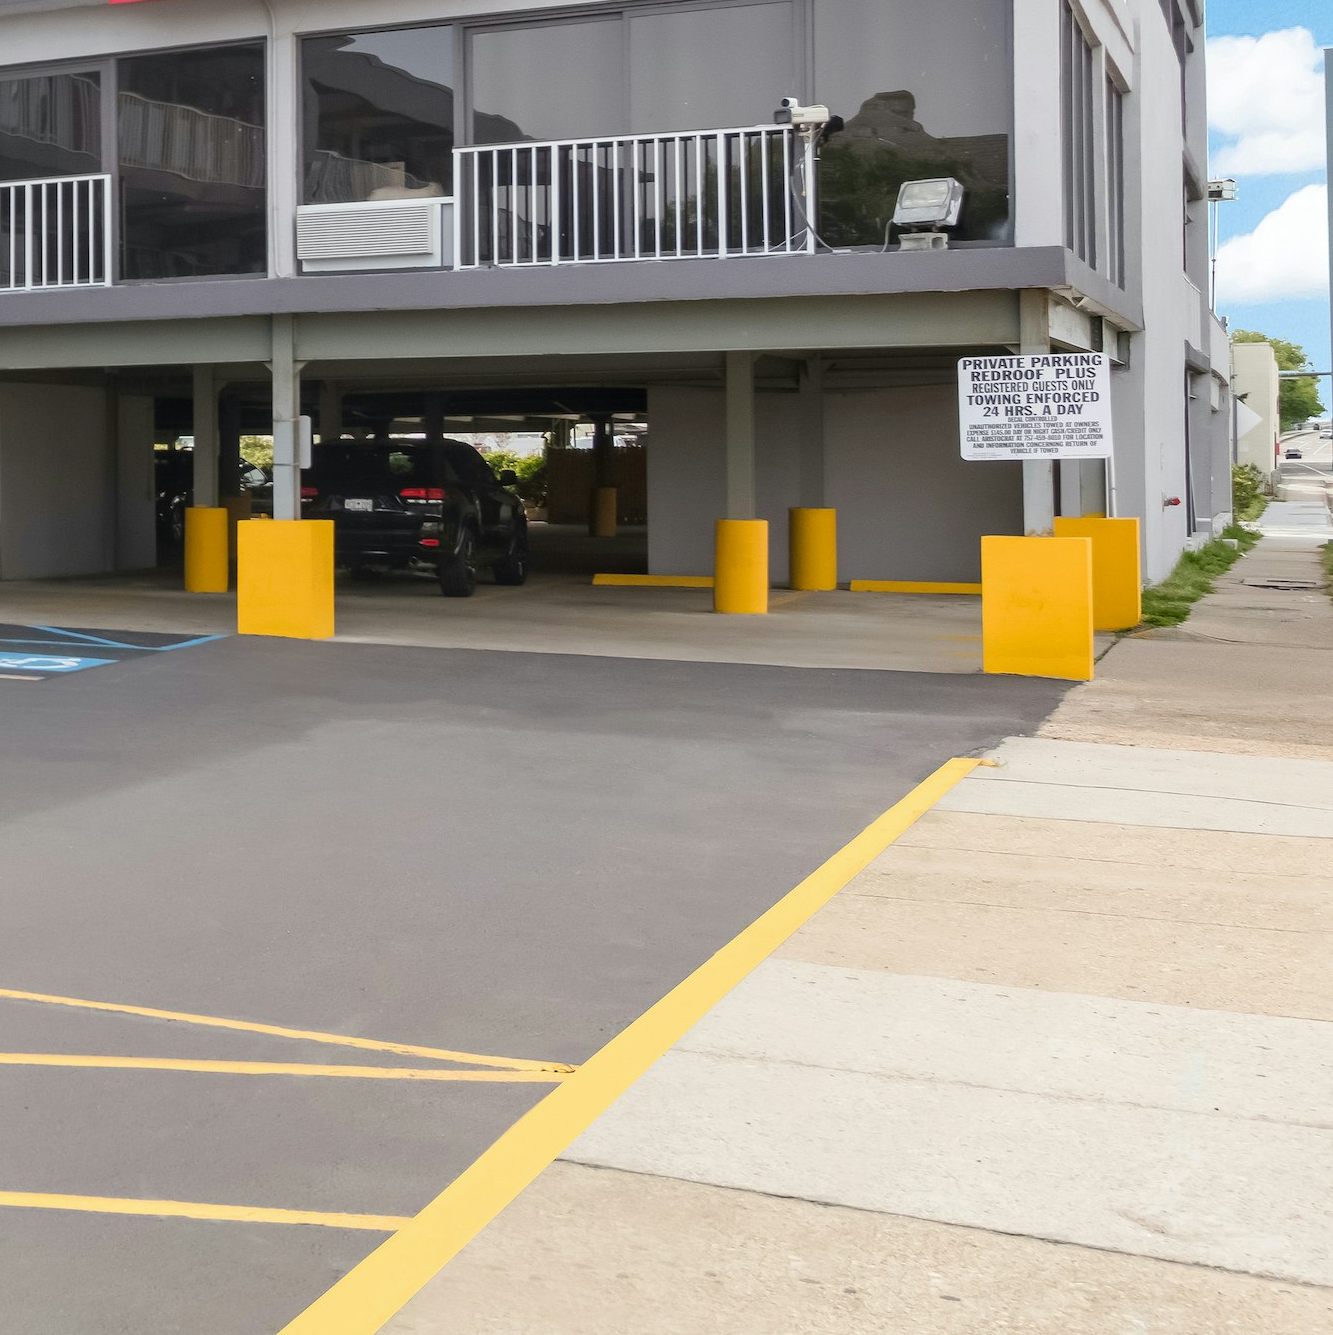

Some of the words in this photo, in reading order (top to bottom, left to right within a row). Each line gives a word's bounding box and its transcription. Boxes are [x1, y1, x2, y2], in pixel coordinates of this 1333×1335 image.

[962, 357, 1025, 370] PRIVATE
[1031, 354, 1102, 368] PARKING
[970, 368, 1044, 382] REDROOF
[1055, 366, 1097, 379] PLUS
[972, 381, 1029, 394] REGISTERED
[1032, 379, 1069, 392] GUESTS
[1071, 379, 1095, 391] ONLY
[966, 393, 1021, 406] TOWING
[1026, 391, 1100, 404] ENFORCED
[983, 406, 1000, 417] 24
[1004, 405, 1037, 416] HRS.
[1042, 404, 1052, 415] A
[1056, 403, 1084, 415] DAY
